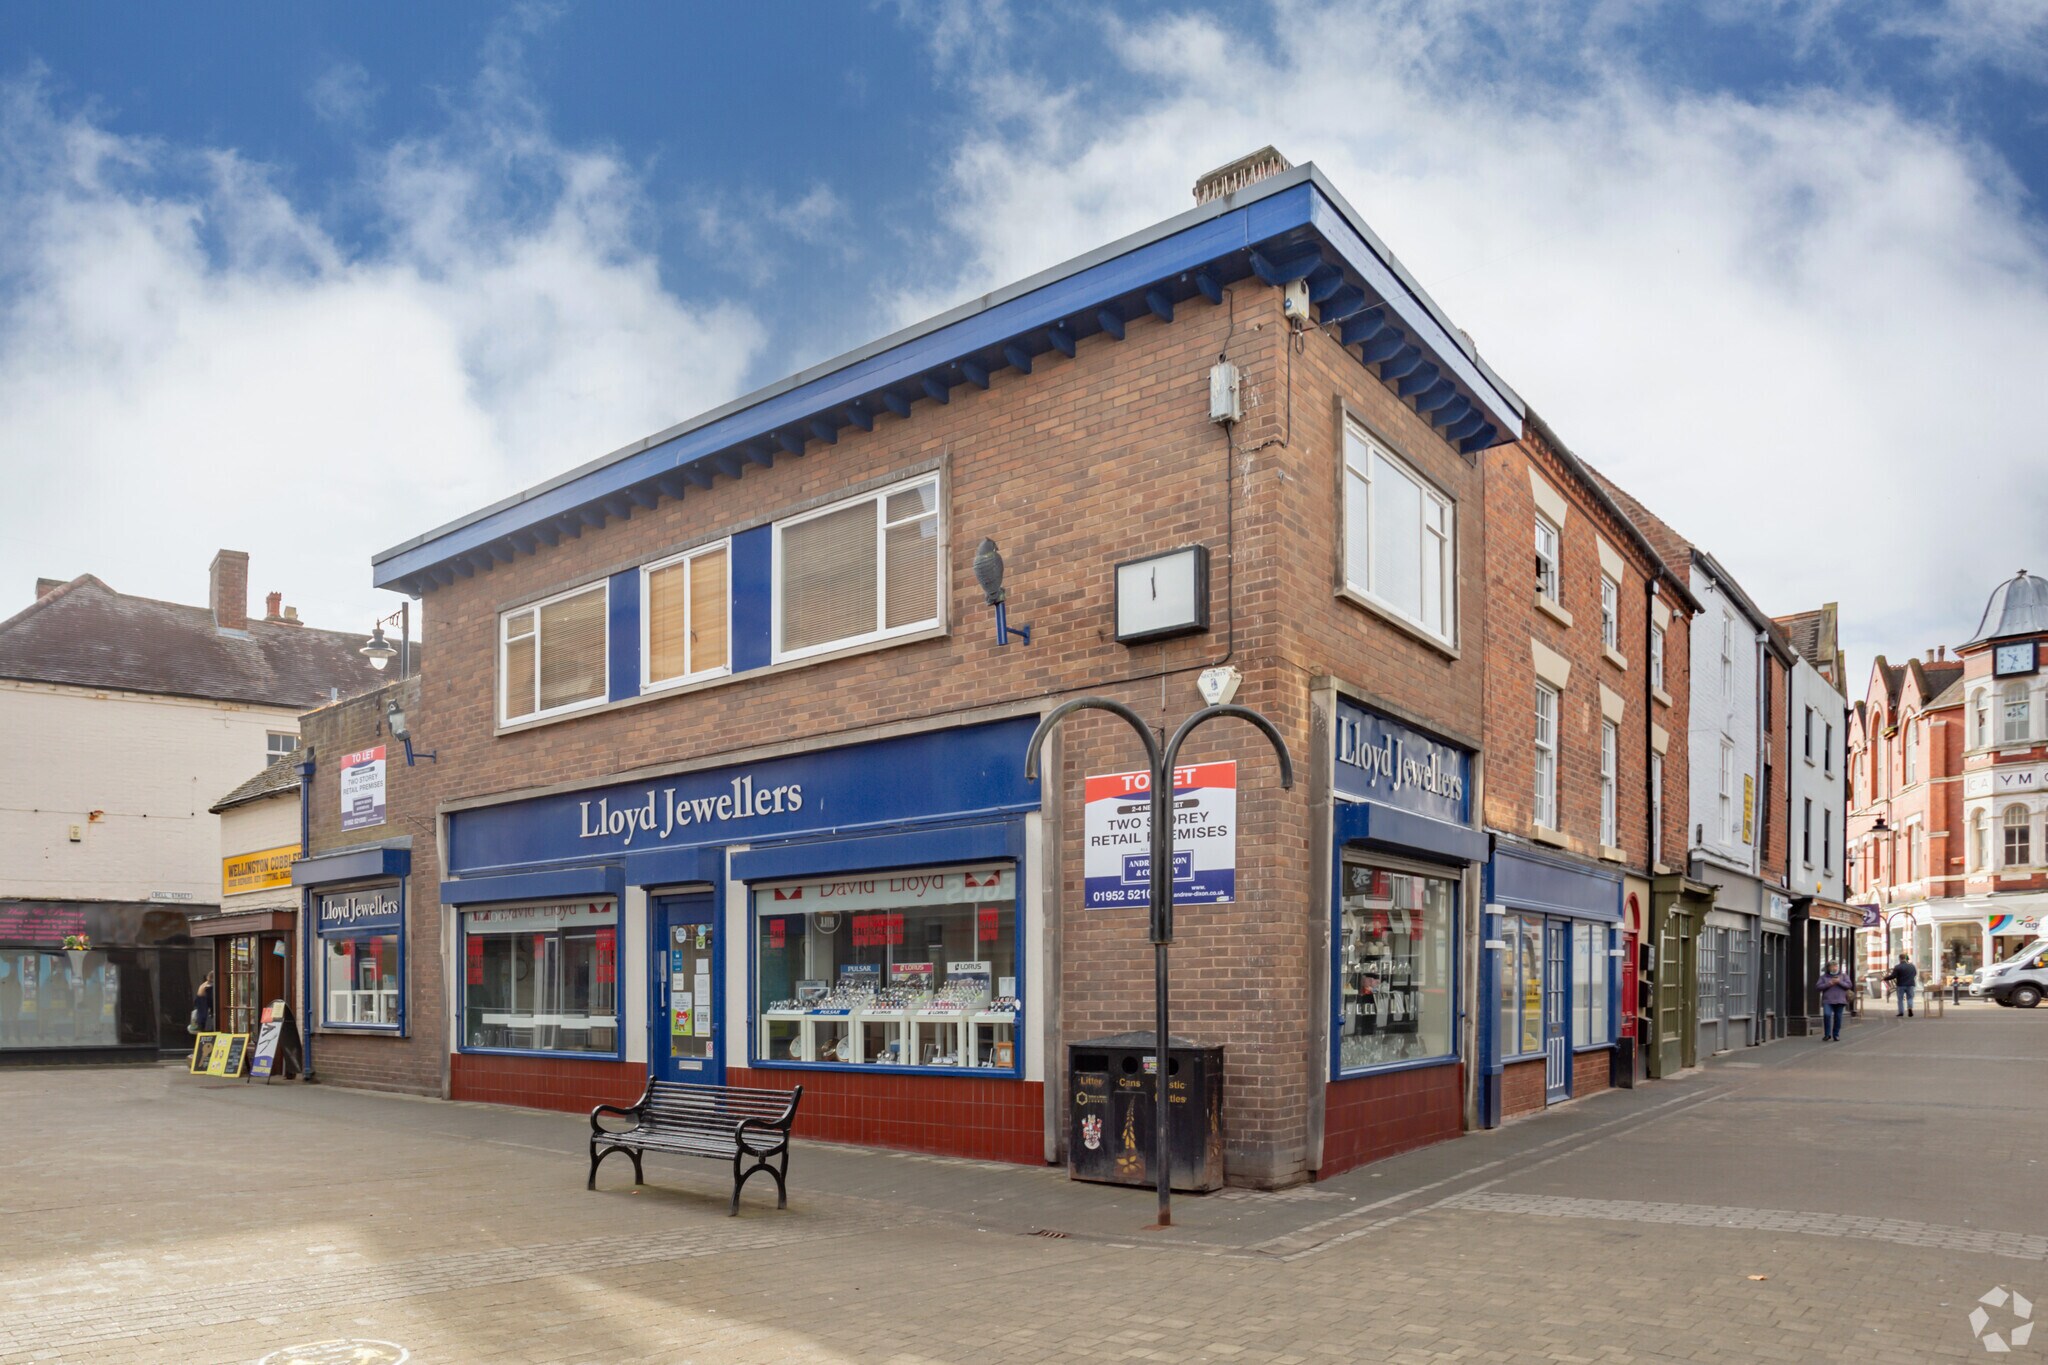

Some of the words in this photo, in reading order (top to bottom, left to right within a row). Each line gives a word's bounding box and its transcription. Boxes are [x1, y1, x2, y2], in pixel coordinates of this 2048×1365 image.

[352, 753, 361, 763] TO
[362, 749, 375, 760] LET
[1339, 716, 1393, 787] Lloyd
[1393, 738, 1463, 801] Jewellers
[1121, 773, 1150, 791] TO
[1173, 768, 1197, 786] ET
[579, 789, 658, 846] Lloyd
[659, 774, 803, 839] Jewellers
[1142, 804, 1151, 812] NE
[1107, 818, 1142, 830] TWO
[1091, 834, 1142, 846] RETAIL
[1147, 825, 1228, 842] EMISES
[228, 858, 269, 878] WELLINGTON
[1128, 859, 1150, 868] ANDR
[1173, 857, 1187, 865] XON
[1093, 891, 1125, 901] 01952
[1127, 889, 1151, 900] 5210
[1173, 890, 1225, 898] andrew-dixon.co.uk
[321, 898, 350, 926] Lloyd
[349, 894, 399, 923] Jewellers
[2025, 922, 2040, 931] ag
[770, 930, 785, 938] SALE
[847, 965, 872, 973] PULSAR
[960, 962, 982, 970] LORUS
[1080, 1076, 1104, 1086] Litter
[1119, 1078, 1141, 1087] Cans
